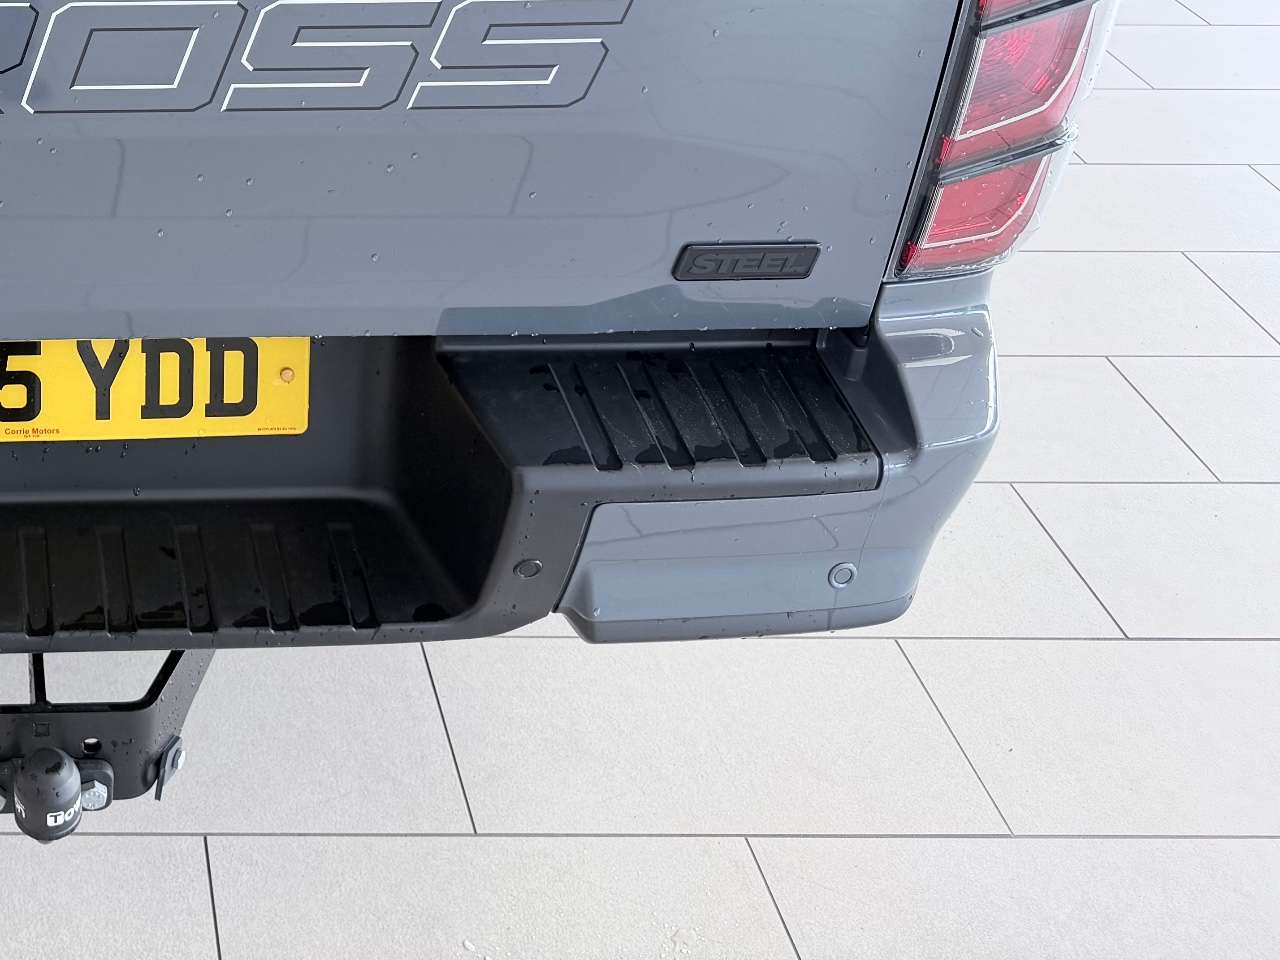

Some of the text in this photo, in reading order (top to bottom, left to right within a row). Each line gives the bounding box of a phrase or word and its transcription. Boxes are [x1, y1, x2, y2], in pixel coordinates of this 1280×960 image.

[687, 251, 806, 274] STEEL
[76, 337, 258, 421] YDD
[4, 427, 60, 435] Corrie Motors
